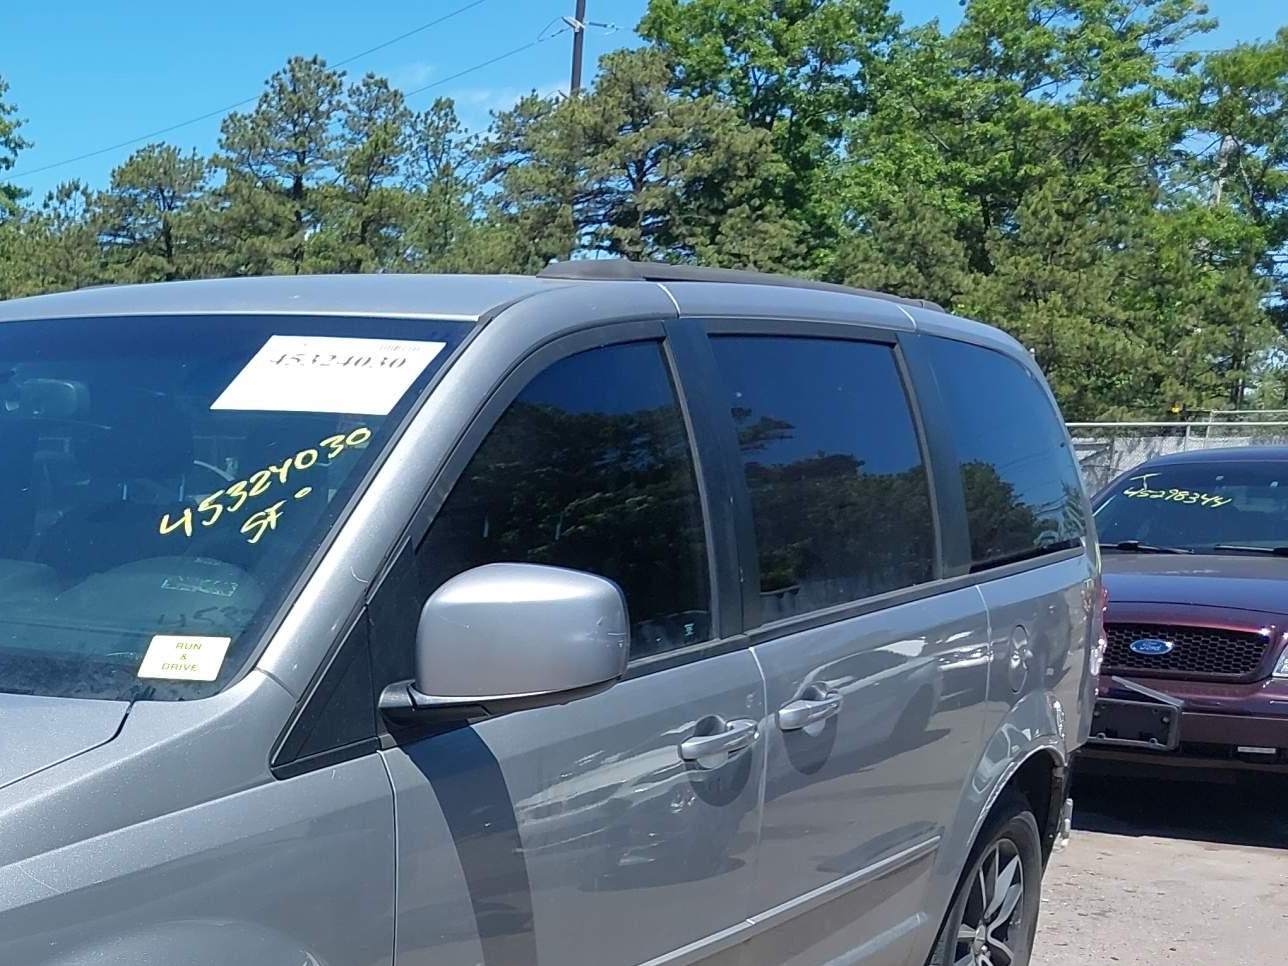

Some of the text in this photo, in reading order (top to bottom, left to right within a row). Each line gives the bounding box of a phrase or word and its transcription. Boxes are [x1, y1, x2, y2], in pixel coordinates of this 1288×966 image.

[159, 427, 372, 537] 45324030
[175, 641, 202, 651] RUN
[179, 653, 187, 661] &
[161, 662, 199, 672] DRIVE
